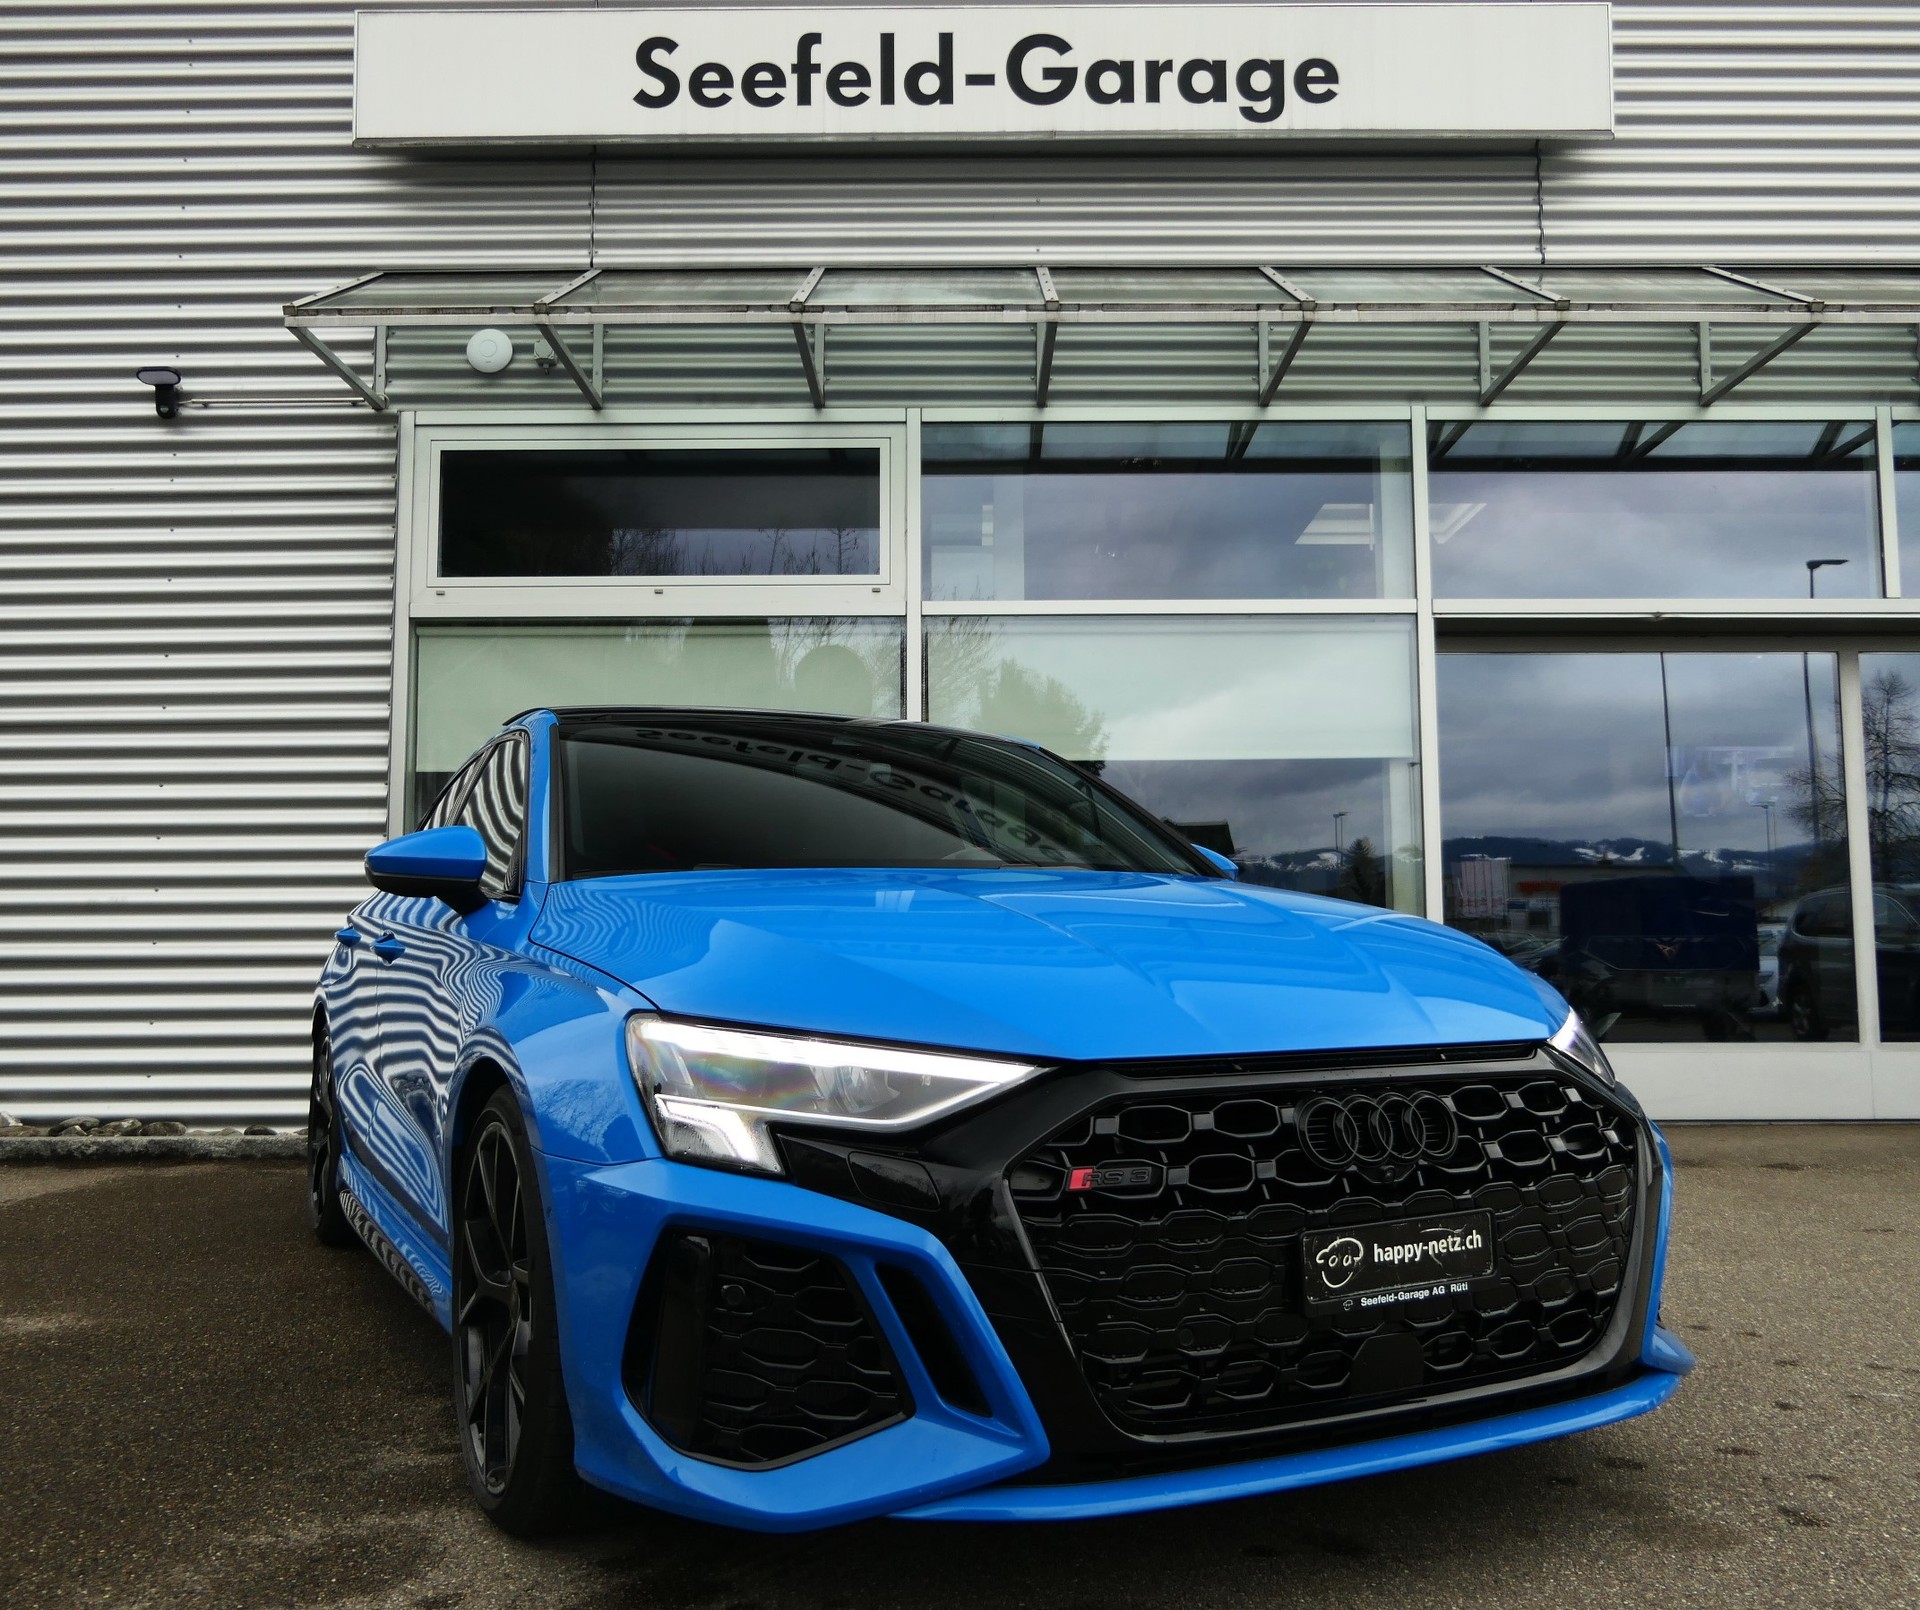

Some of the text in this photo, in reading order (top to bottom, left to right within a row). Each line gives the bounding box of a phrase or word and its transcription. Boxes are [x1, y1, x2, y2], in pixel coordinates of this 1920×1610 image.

[632, 32, 1340, 123] Seefeld-Garage
[1373, 1229, 1482, 1265] happy-netz.ch
[1360, 1281, 1468, 1307] Seefeld-Garage AG Rüti
